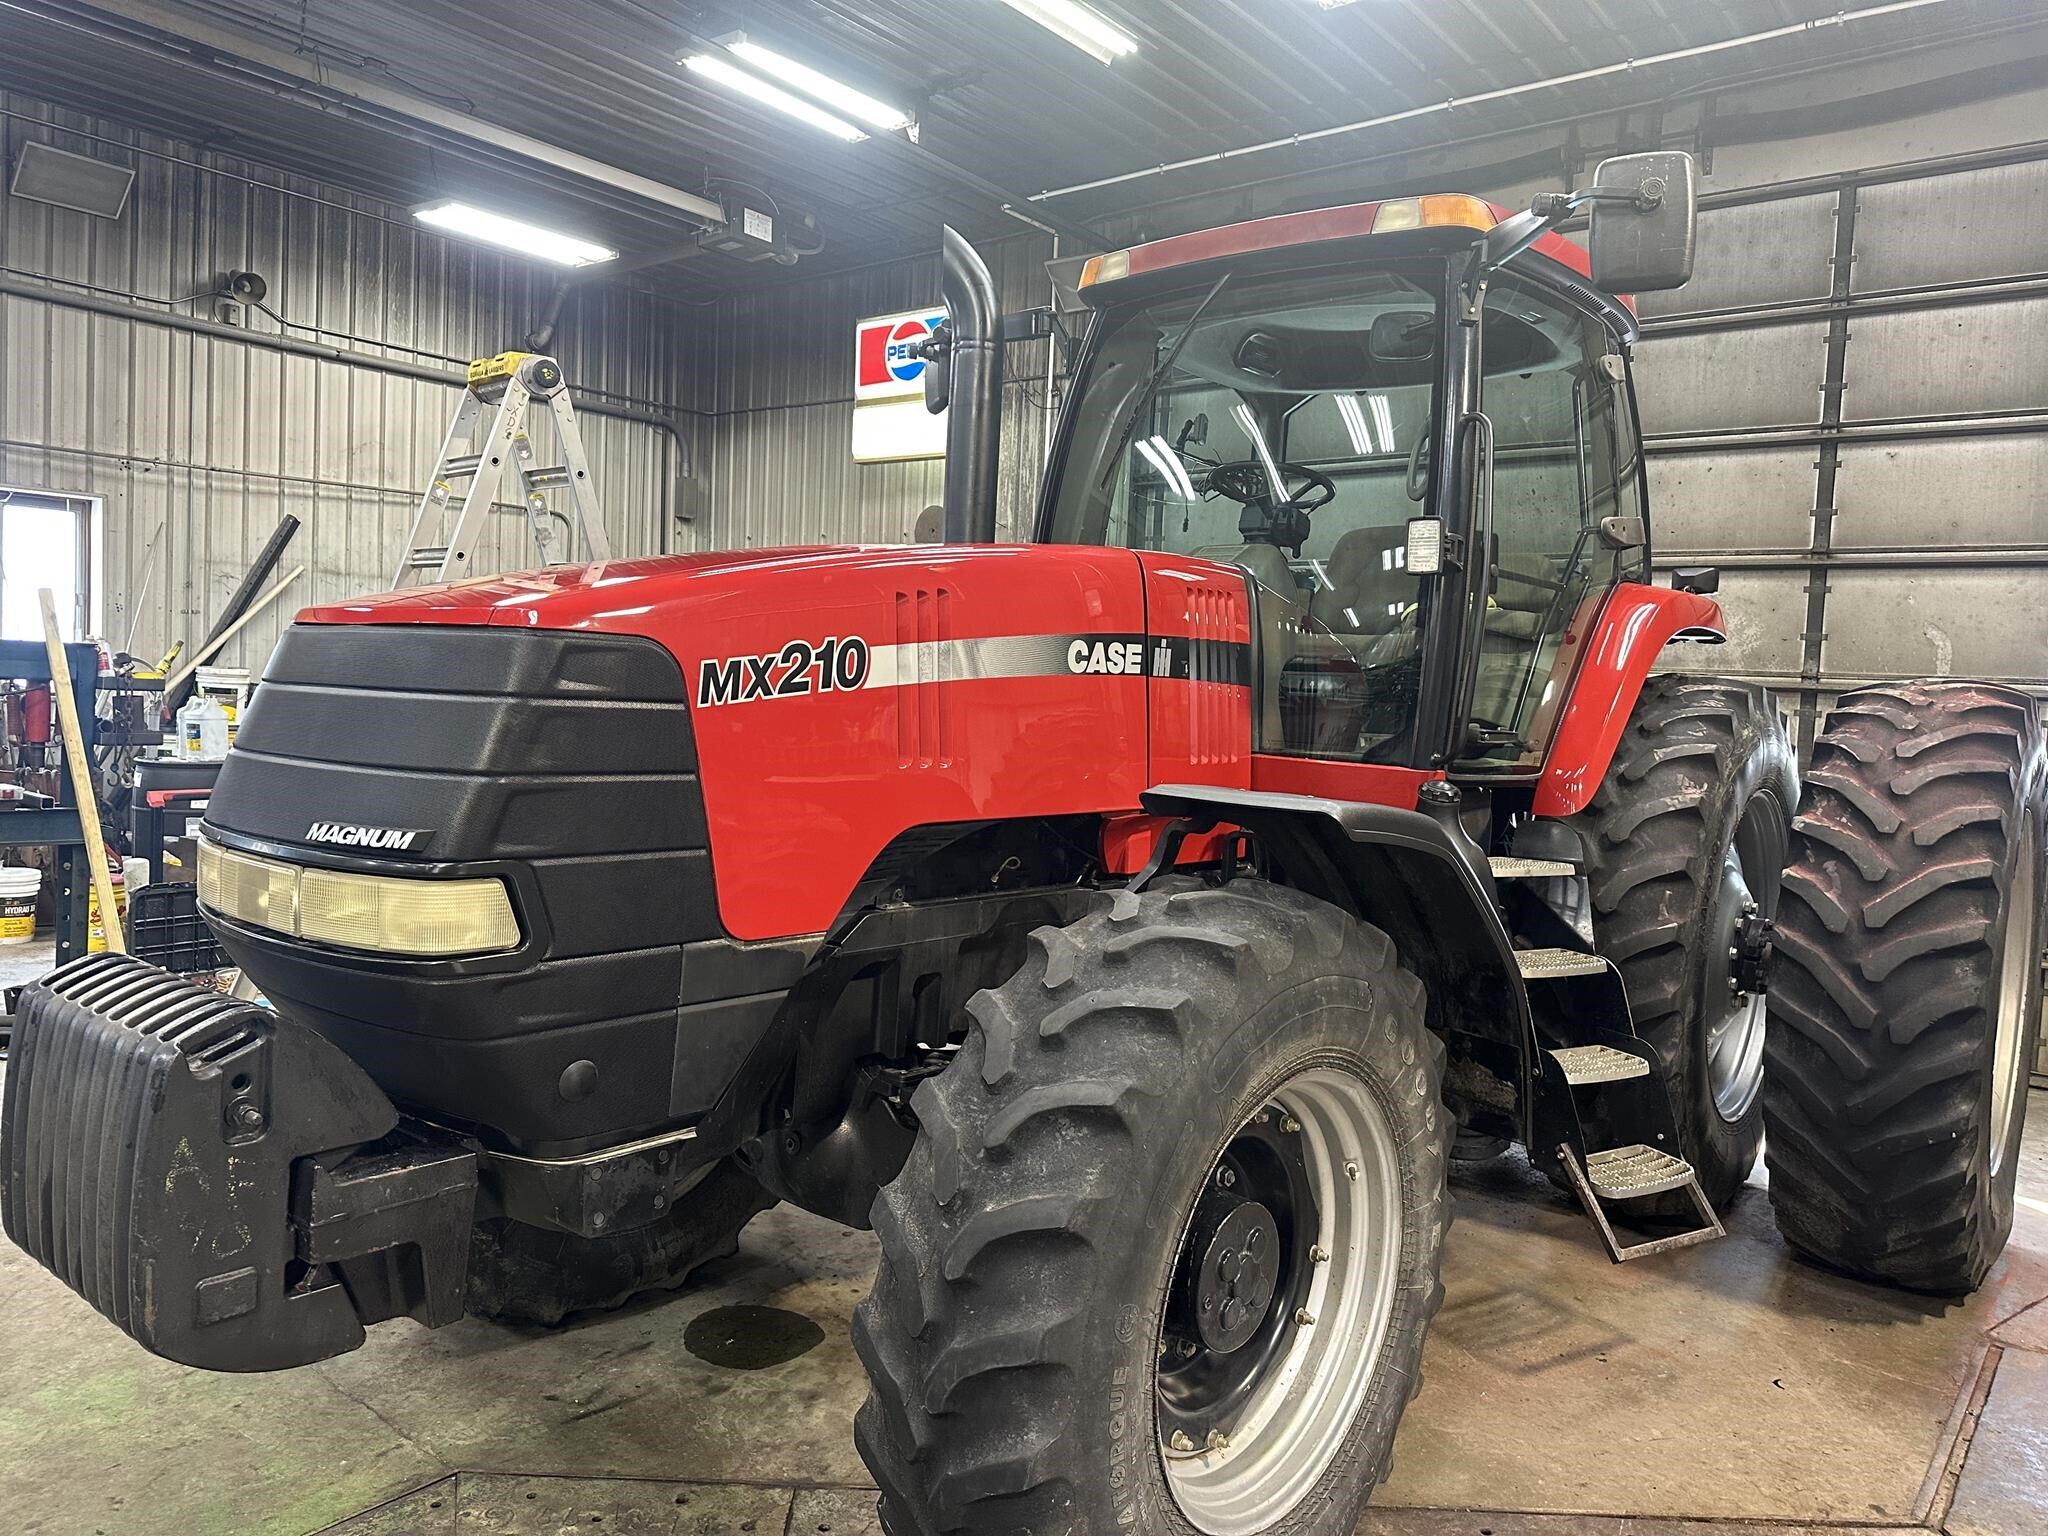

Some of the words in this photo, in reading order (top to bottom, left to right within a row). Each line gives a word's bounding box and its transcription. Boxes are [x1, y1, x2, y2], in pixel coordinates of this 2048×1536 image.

[697, 635, 869, 709] MX210
[1067, 639, 1143, 674] CASE
[304, 822, 416, 850] MAGNUM
